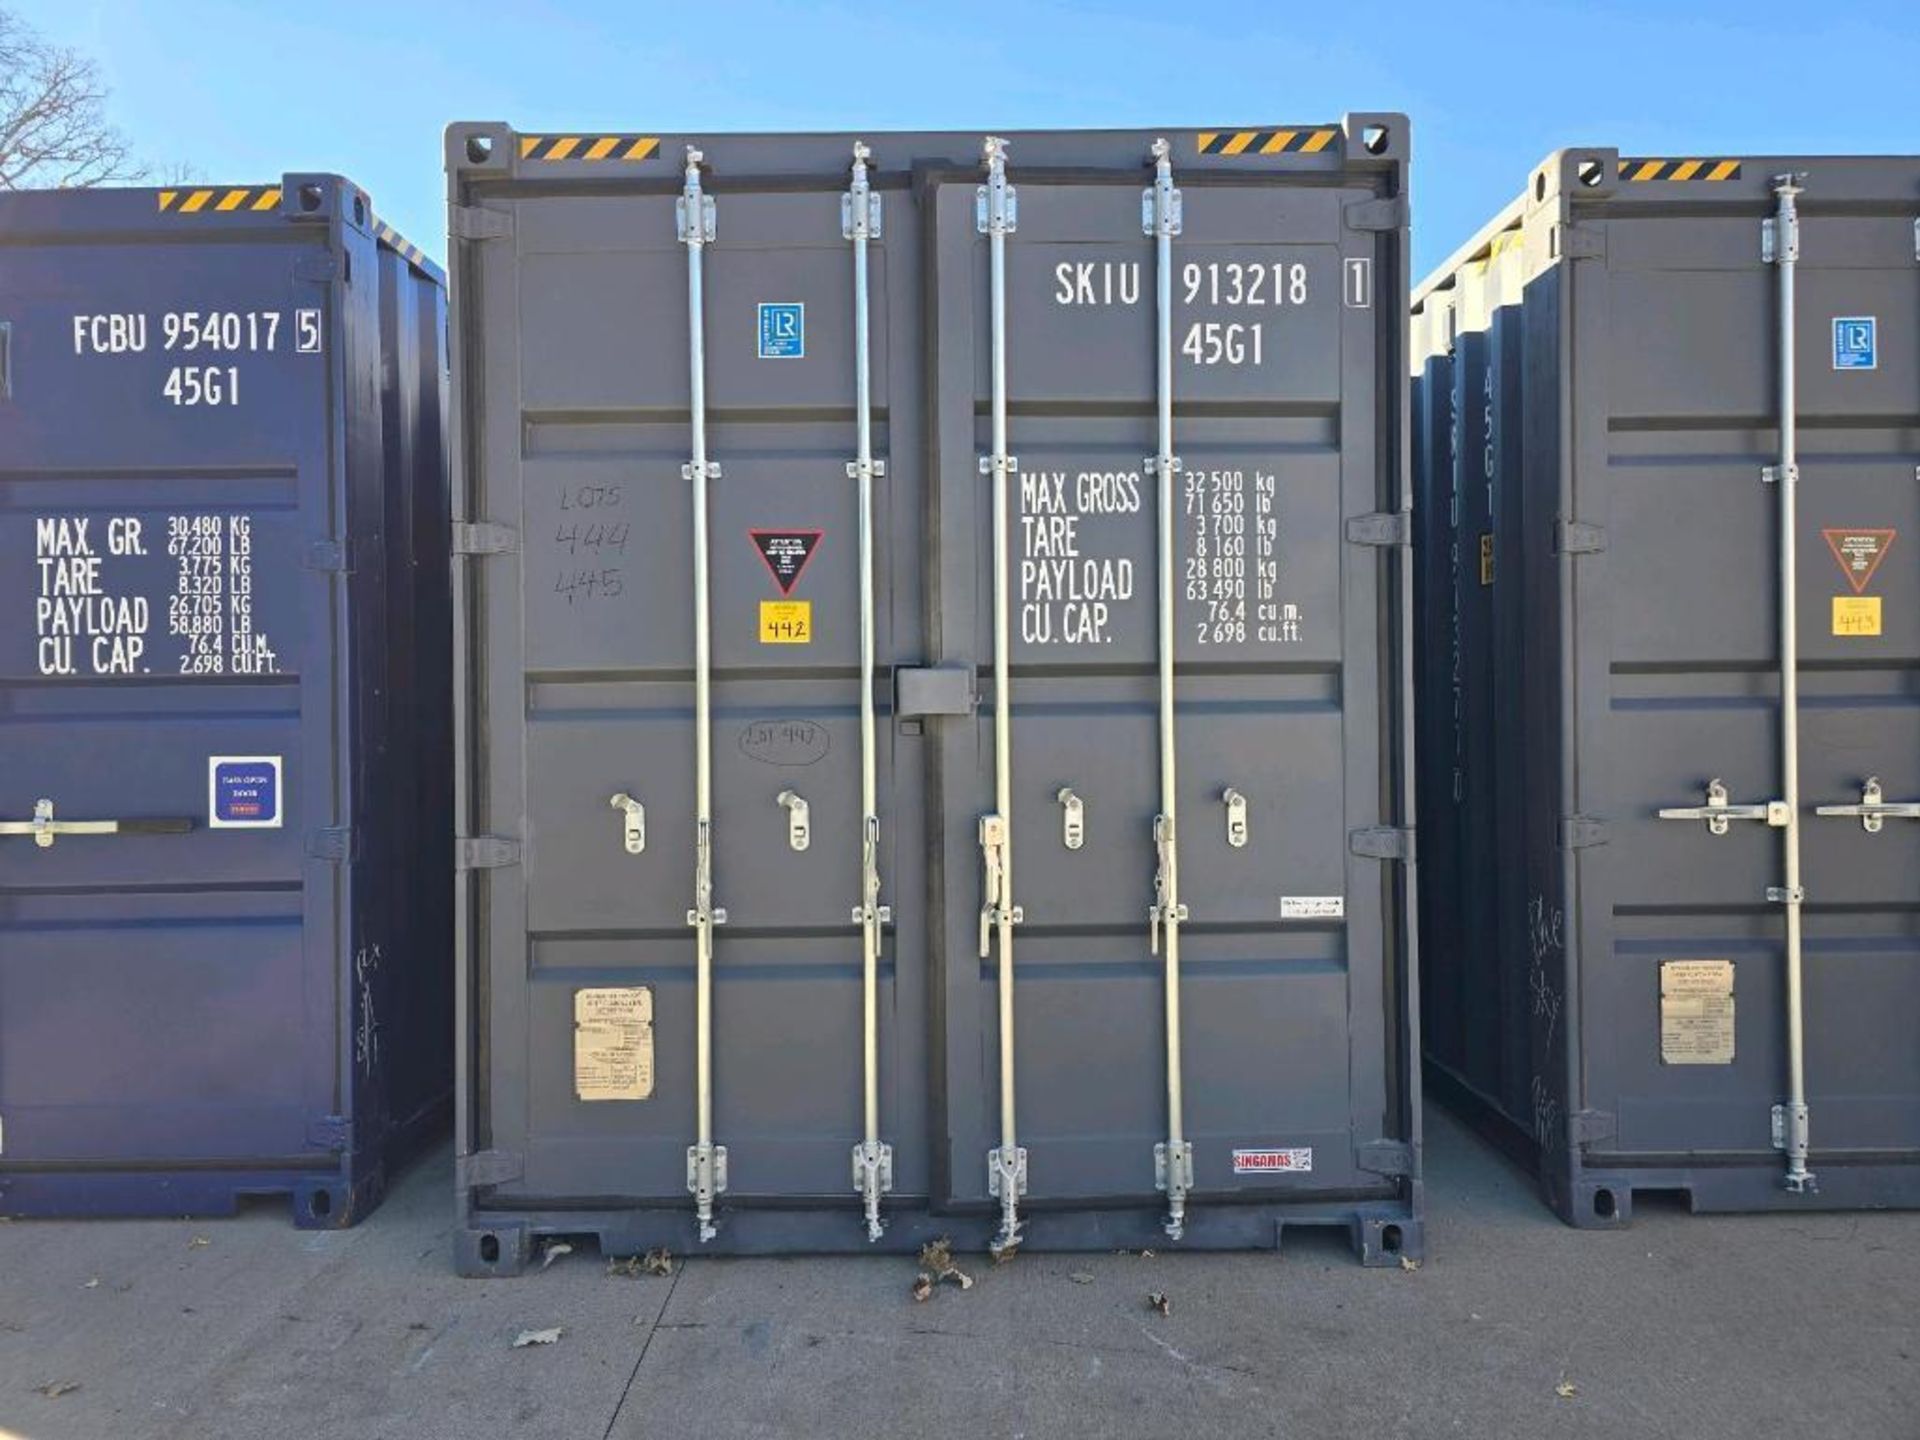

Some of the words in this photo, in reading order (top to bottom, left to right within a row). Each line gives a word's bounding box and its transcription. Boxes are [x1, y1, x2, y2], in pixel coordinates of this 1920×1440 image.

[1056, 263, 1138, 304] SKIU
[1184, 264, 1306, 304] 913218
[1353, 263, 1362, 302] 1
[74, 314, 145, 353] FCBU
[164, 313, 279, 350] 954017
[301, 311, 317, 348] 5
[1183, 323, 1261, 364] 45G1
[164, 367, 237, 405] 45G1
[1483, 367, 1493, 516] 45G1
[1021, 473, 1066, 513] MAX
[1077, 472, 1140, 513] GROSS
[1186, 472, 1205, 494] 32
[1212, 471, 1242, 494] 500
[1256, 472, 1274, 498] kg
[1186, 495, 1203, 516] 71
[1212, 494, 1244, 516] 650
[1257, 494, 1274, 513] lb
[37, 518, 94, 556] MAX.
[109, 518, 147, 554] GR.
[169, 516, 221, 536] 30.480
[230, 516, 249, 535] KG
[555, 523, 630, 554] 444
[1022, 516, 1078, 557] TARE
[1197, 515, 1205, 536] 3
[1213, 515, 1244, 537] 700
[1257, 515, 1276, 541] kg
[168, 536, 221, 555] 67.200
[230, 536, 250, 555] LB
[1197, 537, 1207, 556] 8
[1216, 537, 1244, 556] 160
[1257, 537, 1275, 556] lb
[38, 558, 102, 595] TARE
[179, 556, 221, 575] 3.775
[231, 556, 250, 575] KG
[1187, 558, 1207, 579] 28
[1213, 558, 1244, 580] 800
[1258, 558, 1276, 584] kg
[179, 576, 221, 594] 8.320
[231, 576, 250, 594] LB
[1022, 559, 1132, 600] PAYLOAD
[1187, 580, 1207, 600] 63
[1213, 580, 1244, 599] 490
[1258, 579, 1275, 599] lb
[38, 597, 148, 635] PAYLOAD
[170, 595, 221, 615] 26.705
[231, 595, 250, 615] KG
[1208, 601, 1244, 621] 76.4
[170, 615, 222, 634] 58.880
[232, 615, 250, 633] LB
[768, 620, 807, 638] 442
[1198, 623, 1207, 643] 2
[1214, 622, 1245, 643] 698
[39, 637, 76, 674] CU.
[93, 636, 149, 673] CAP.
[189, 634, 222, 654] 76.4
[180, 655, 223, 674] 2.698
[232, 654, 280, 673] CU.FT.
[1233, 1154, 1292, 1167] SINGAMAS
